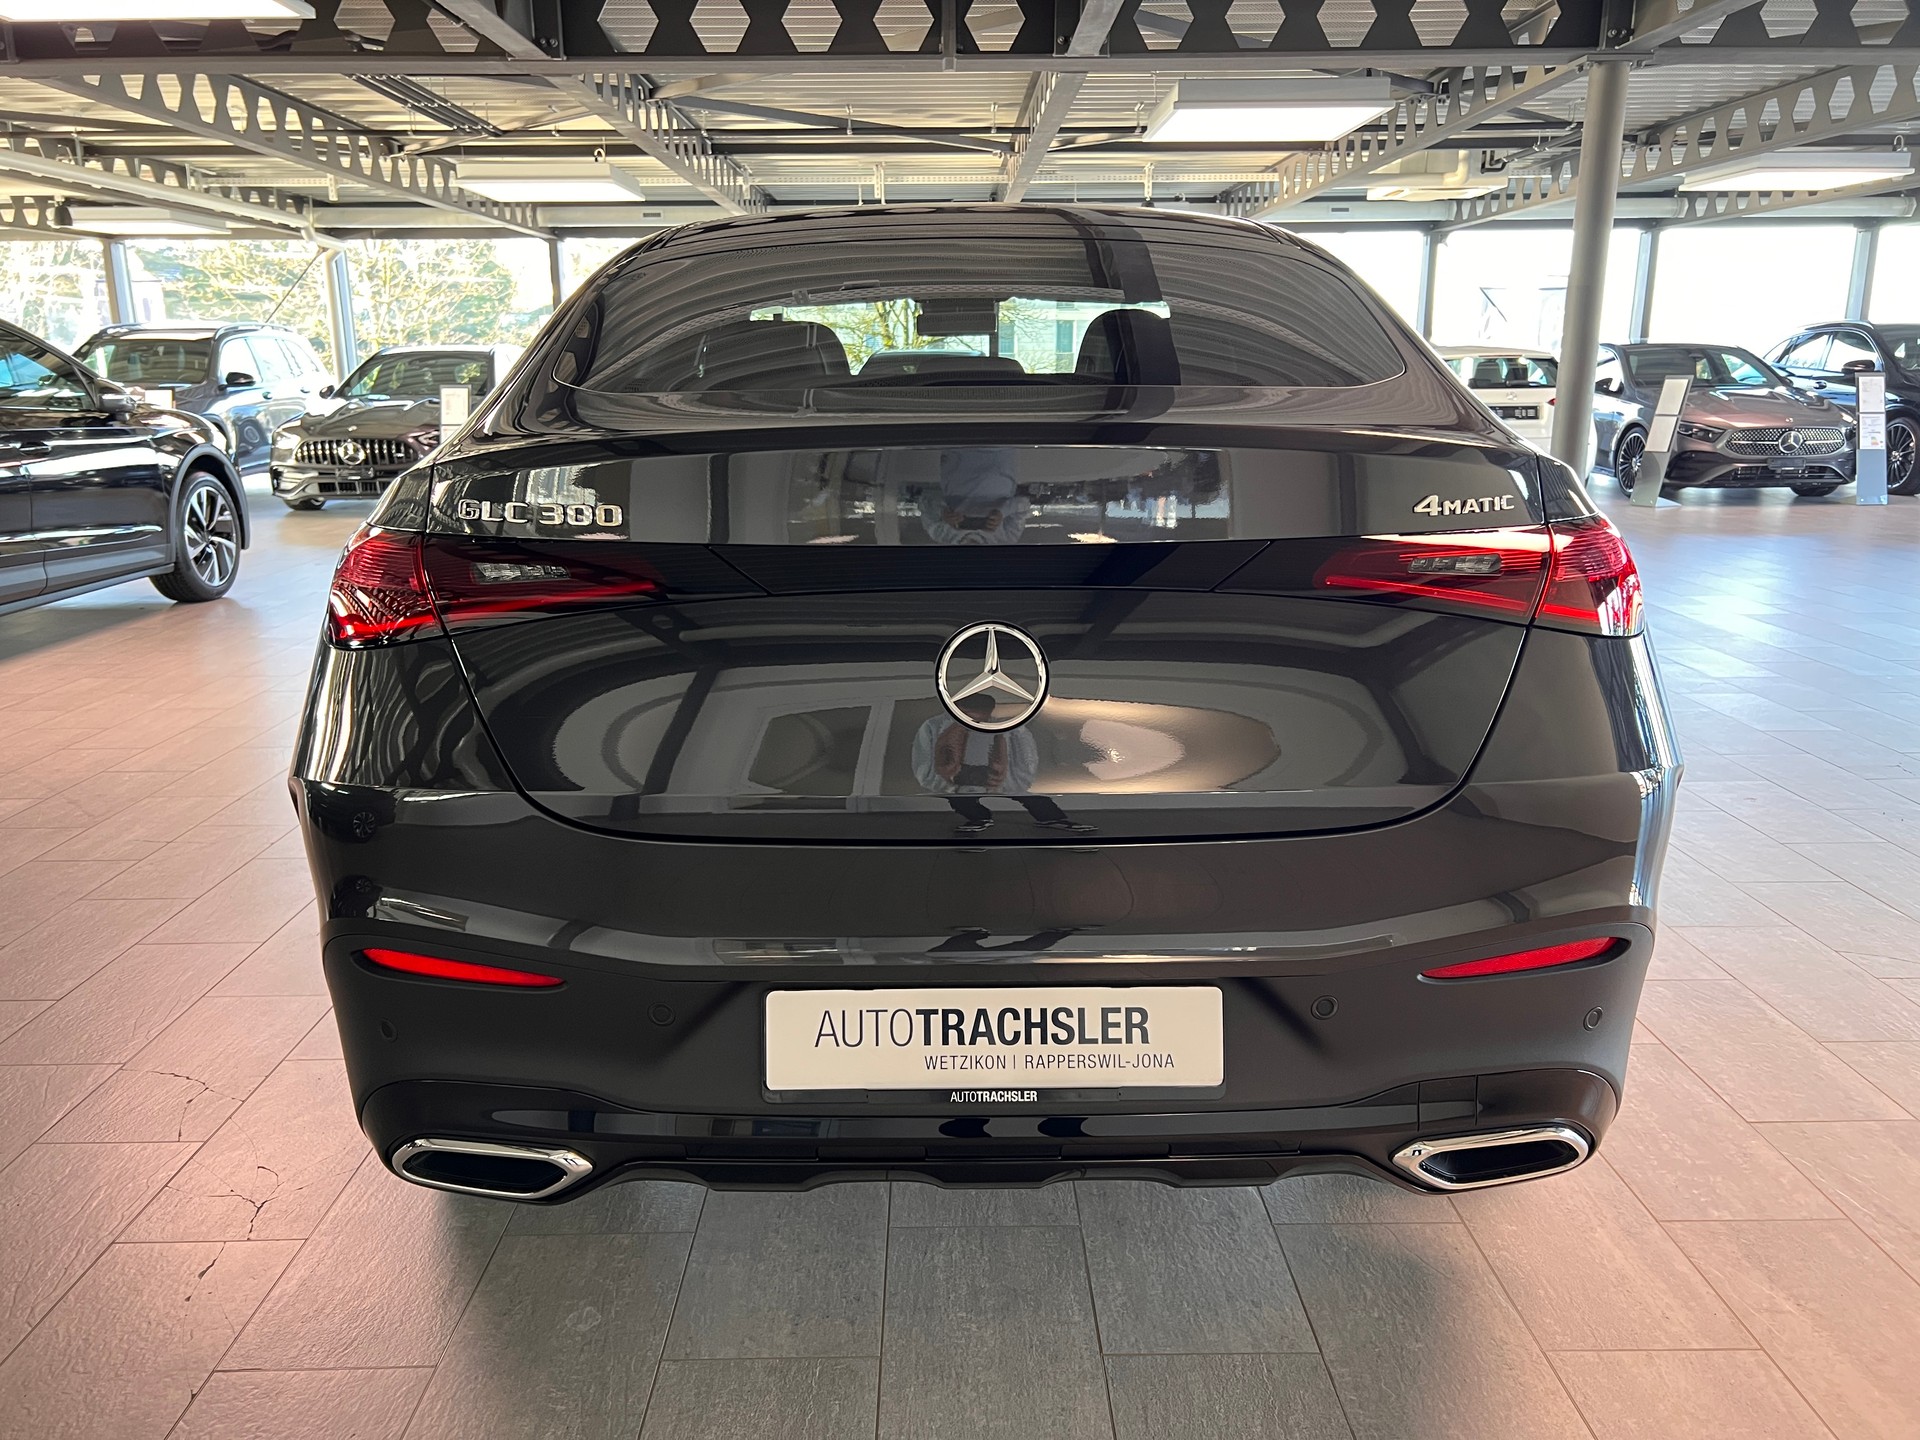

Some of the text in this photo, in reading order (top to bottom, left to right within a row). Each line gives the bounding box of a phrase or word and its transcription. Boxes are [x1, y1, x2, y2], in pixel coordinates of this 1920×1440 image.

[458, 498, 624, 527] GLC 300
[1413, 494, 1516, 516] 4MATIC
[814, 1006, 1151, 1048] AUTOTRACHSLER
[924, 1054, 1007, 1070] WETZIKON
[1024, 1053, 1175, 1070] RAPPERSWIL-JONA
[950, 1090, 1039, 1103] AUTOTRACHSLER
